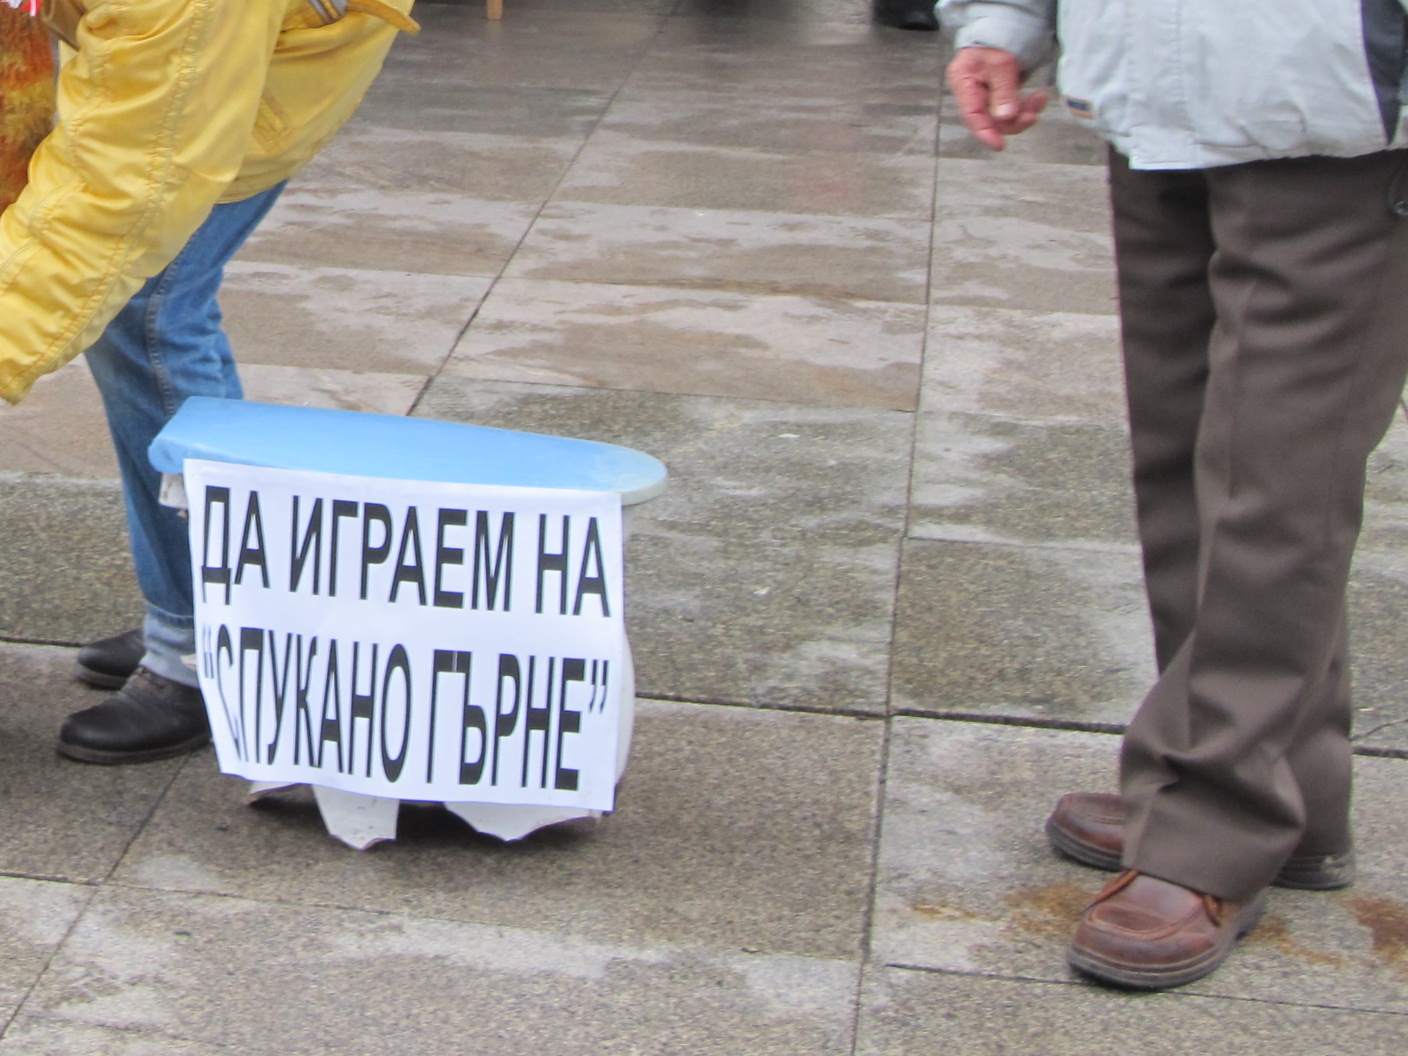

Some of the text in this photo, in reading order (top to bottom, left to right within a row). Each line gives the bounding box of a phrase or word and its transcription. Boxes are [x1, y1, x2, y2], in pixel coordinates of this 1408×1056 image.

[201, 485, 611, 618] ДА ИГРАЕМ НА
